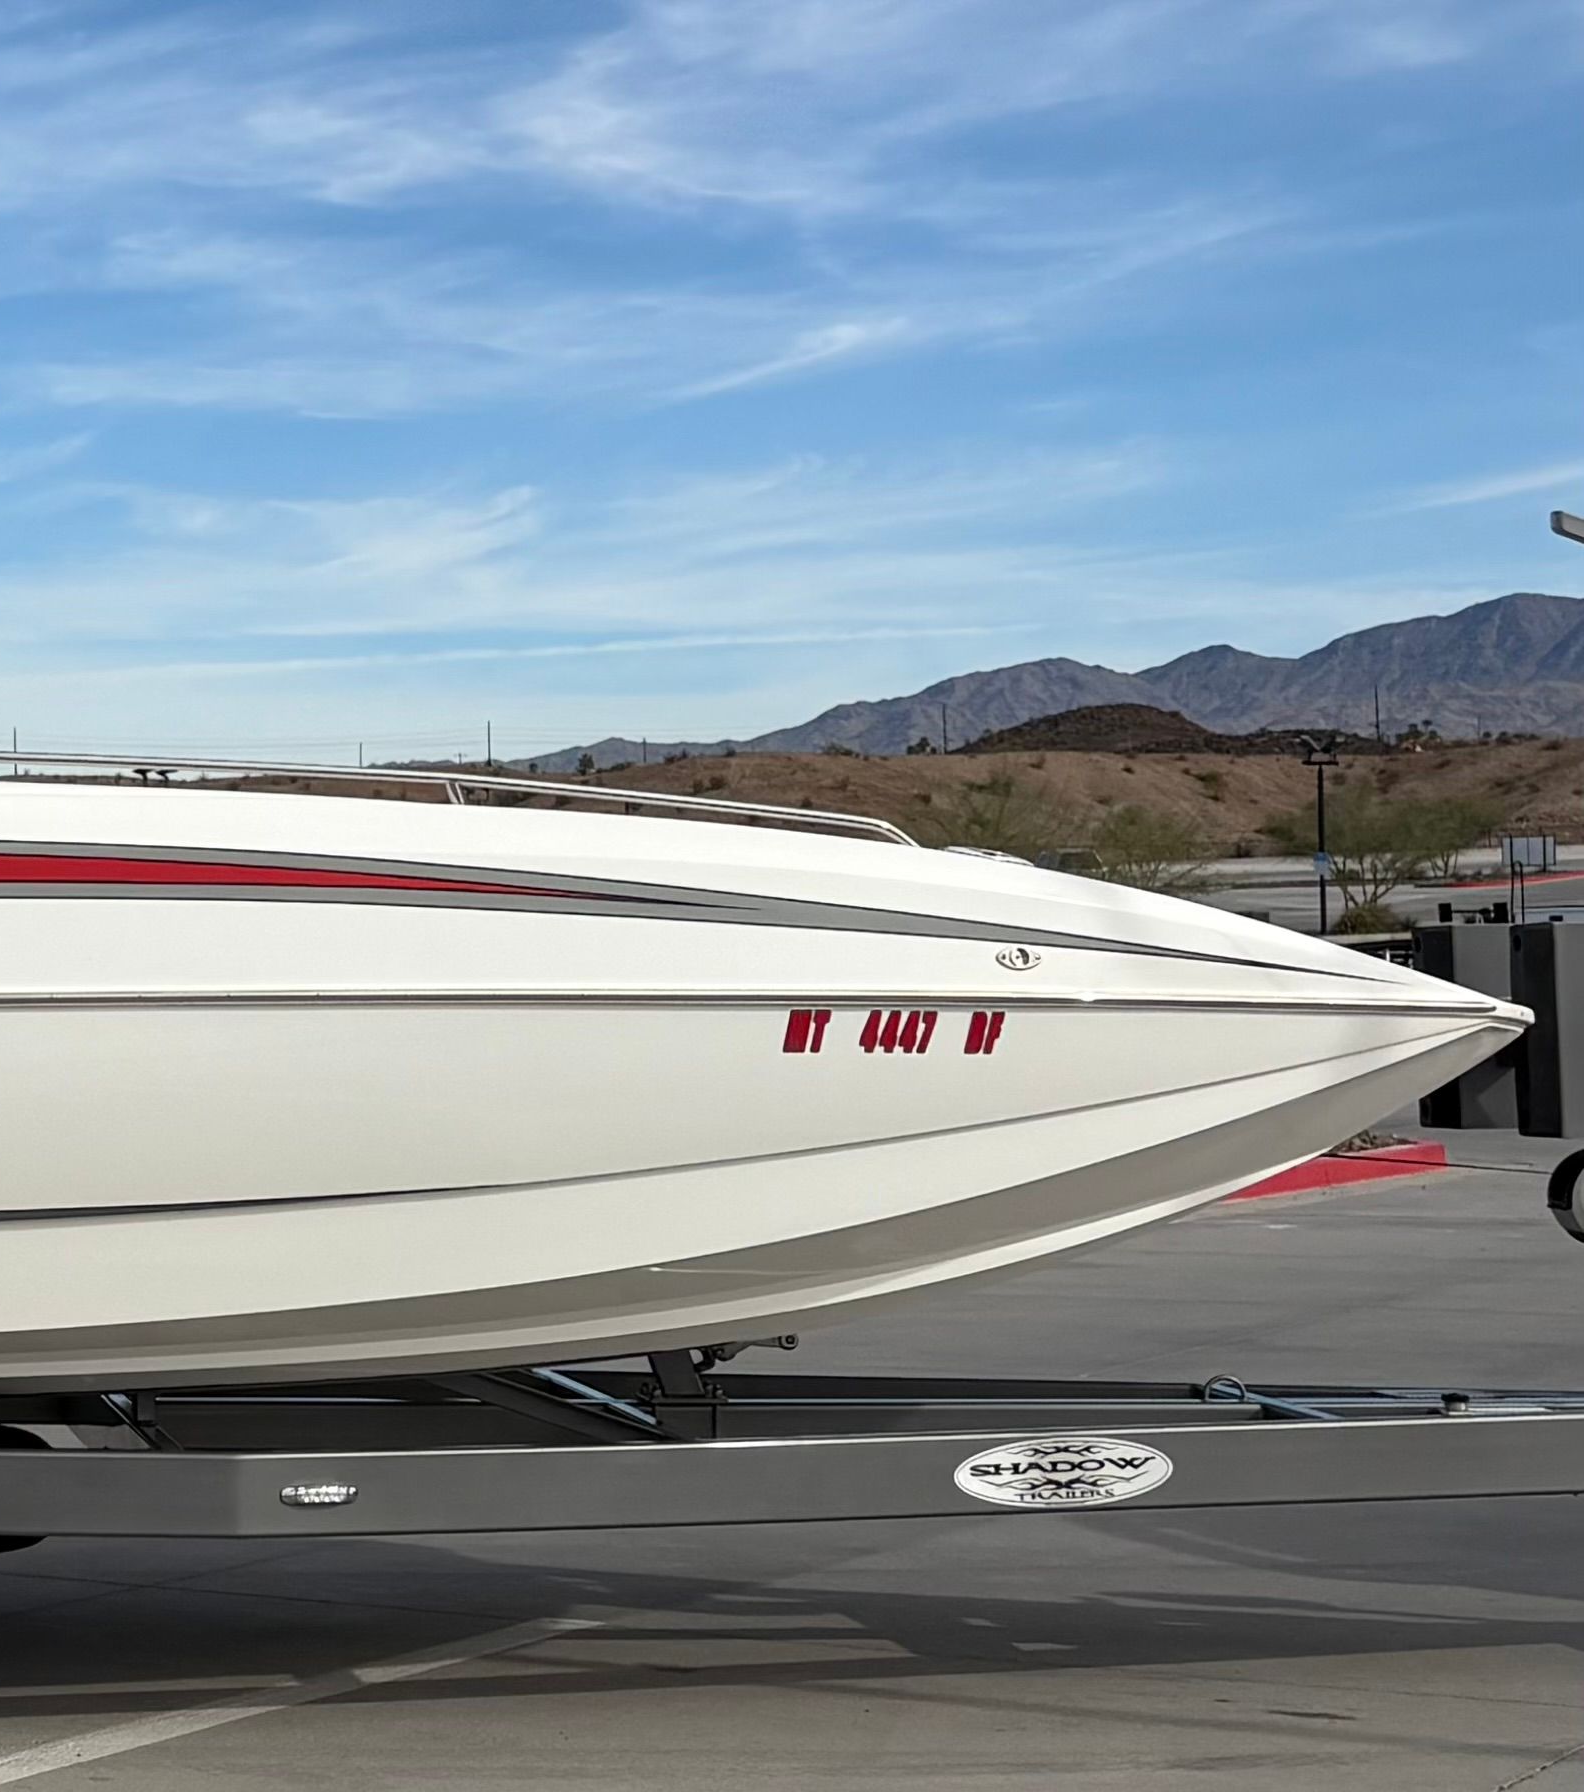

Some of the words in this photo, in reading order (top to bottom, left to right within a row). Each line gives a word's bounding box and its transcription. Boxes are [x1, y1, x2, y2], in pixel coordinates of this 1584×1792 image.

[858, 1009, 938, 1053] 4447
[969, 1456, 1156, 1477] SHADOW
[1014, 1488, 1115, 1501] TRAILERS
